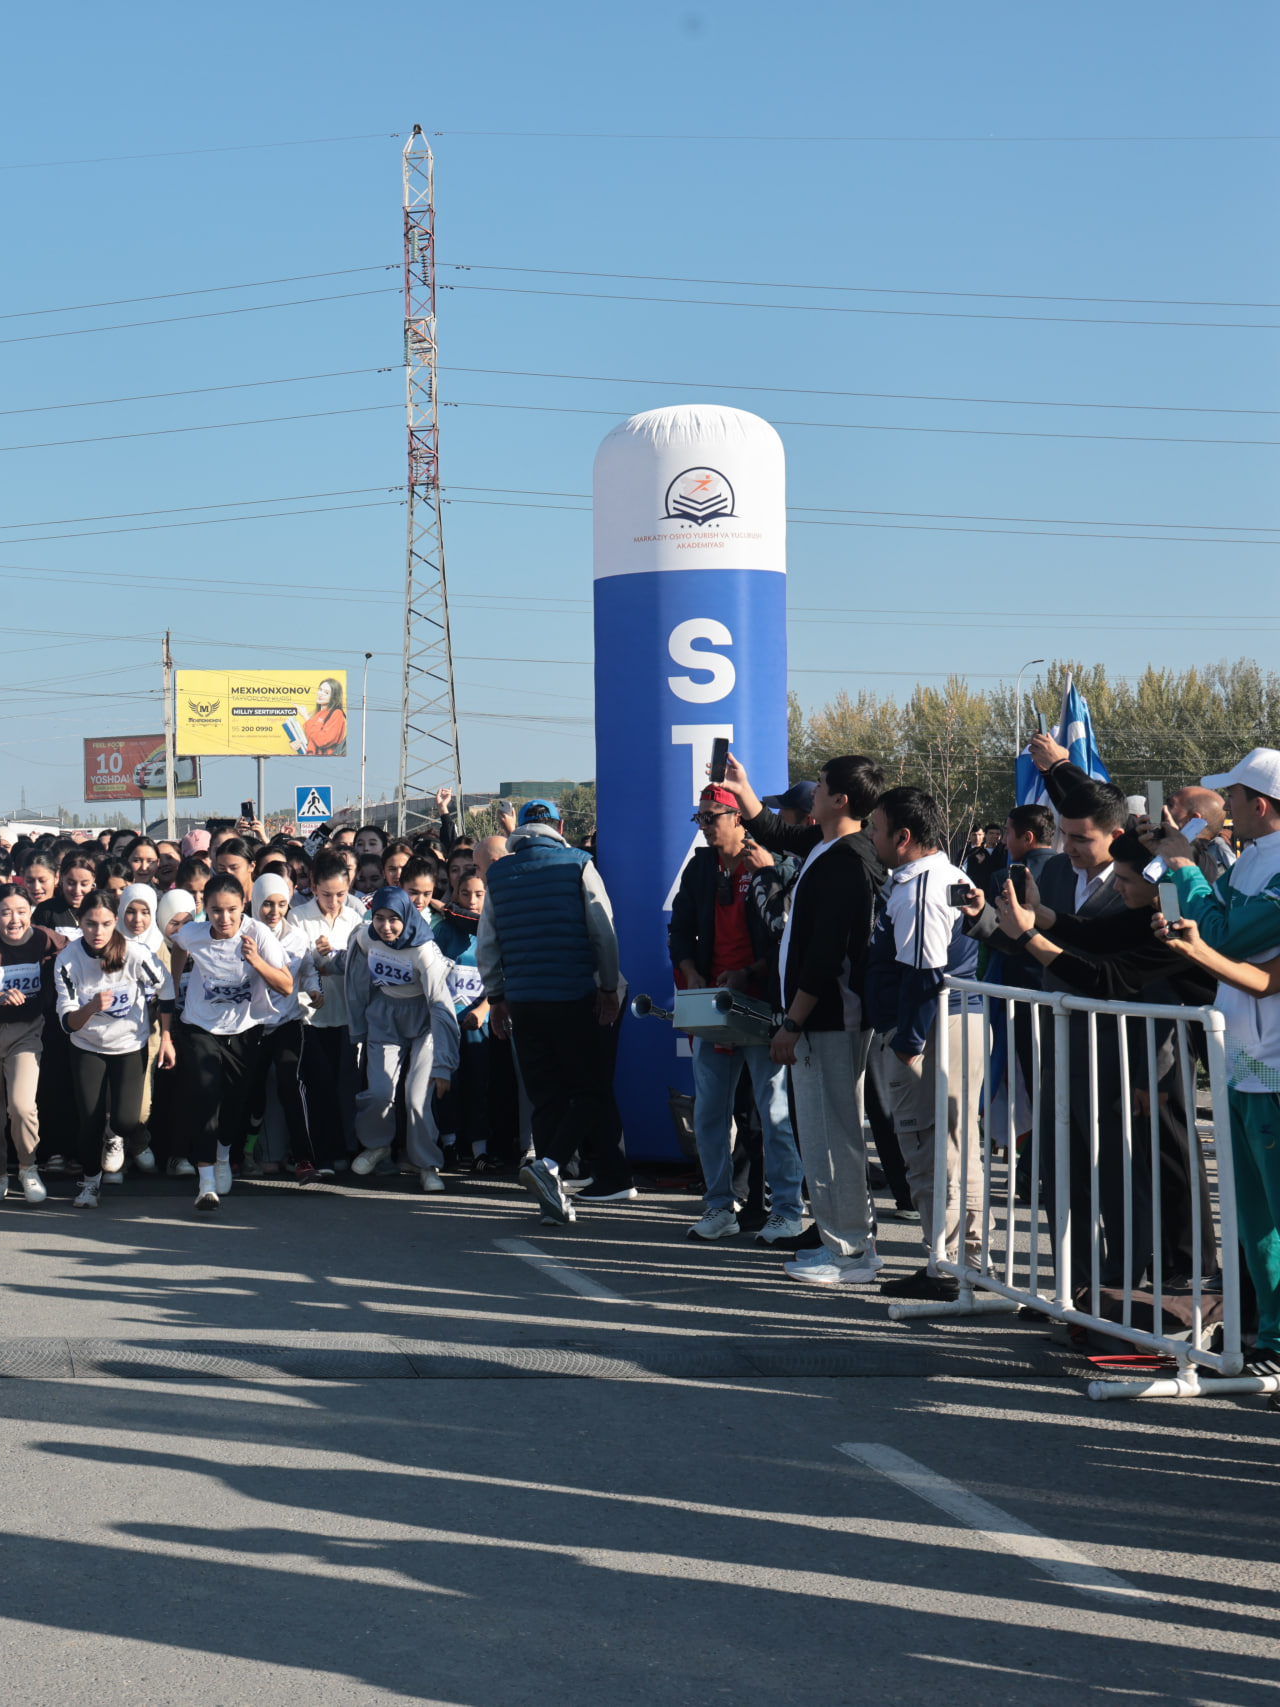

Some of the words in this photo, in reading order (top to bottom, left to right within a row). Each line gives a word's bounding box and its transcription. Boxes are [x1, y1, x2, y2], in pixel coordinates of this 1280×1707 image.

[633, 534, 668, 543] MARKAZIY
[669, 532, 692, 540] OSIYO
[677, 541, 724, 549] AKADEMIYASI
[96, 752, 123, 774] 10
[90, 774, 130, 784] YOSHDA!
[374, 962, 412, 983] 8236
[3, 976, 40, 991] 3820
